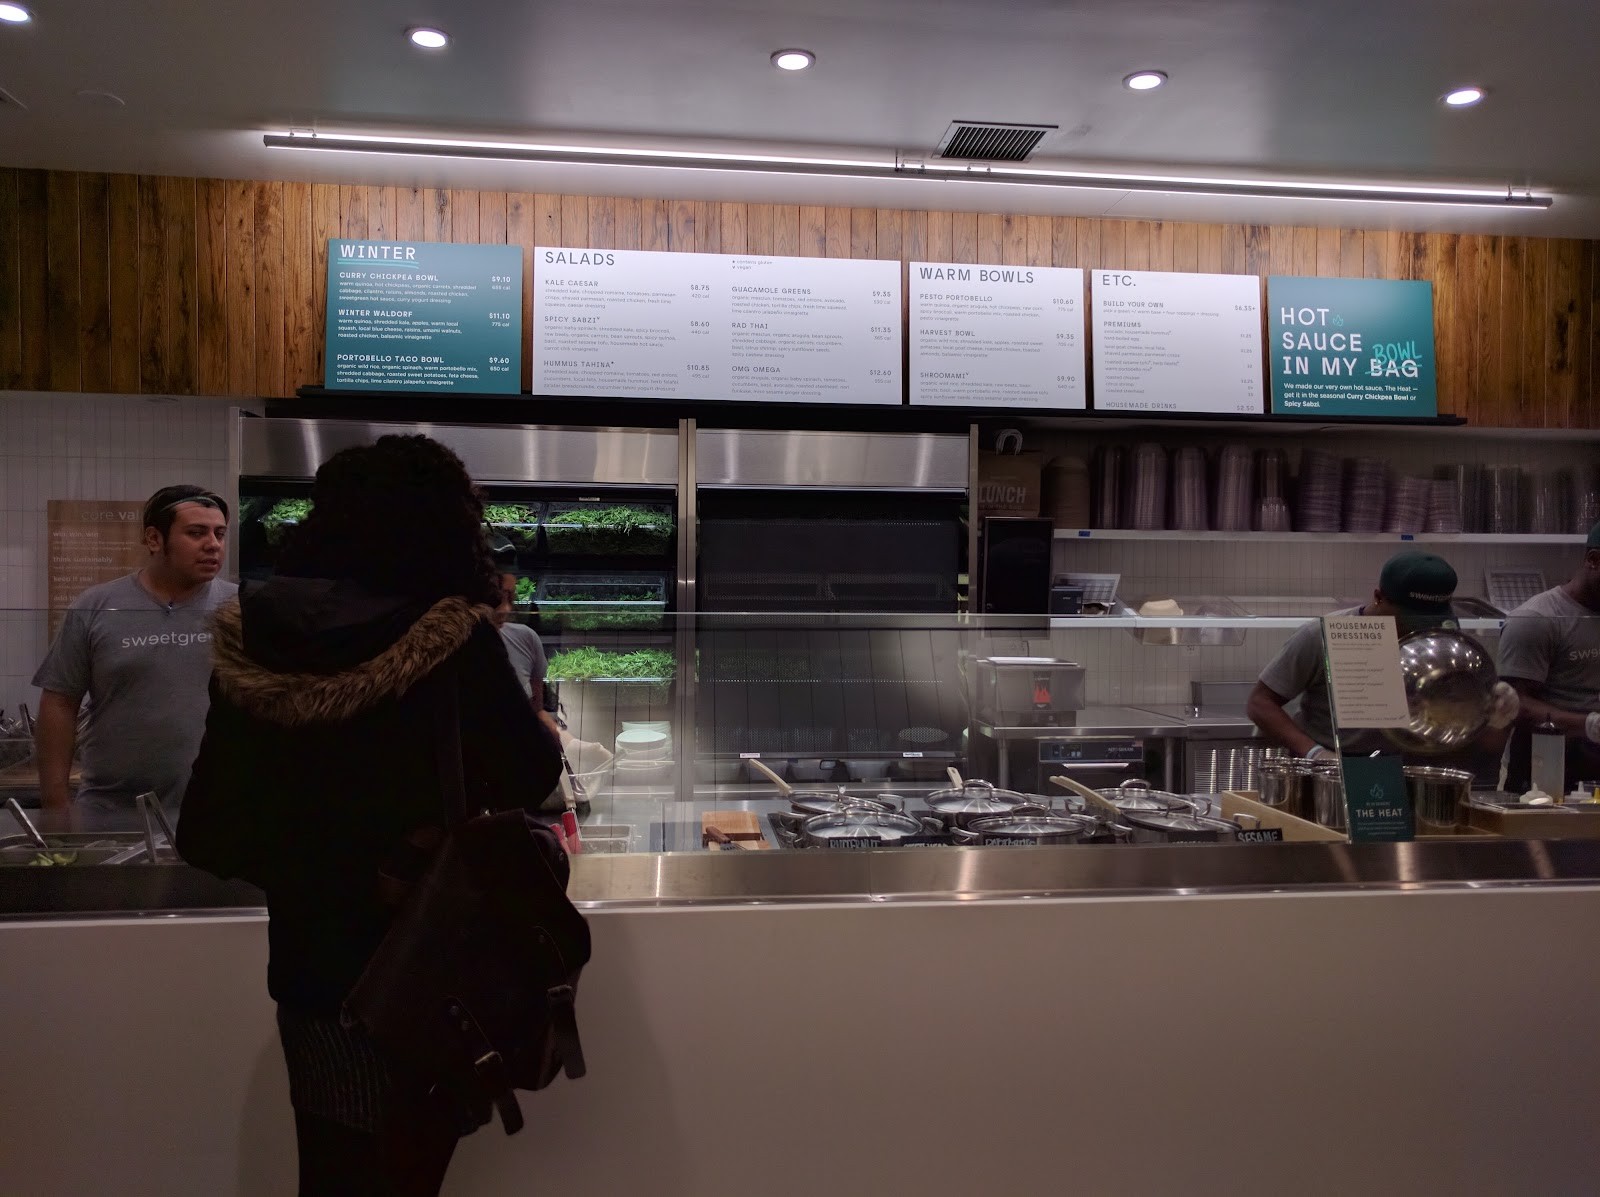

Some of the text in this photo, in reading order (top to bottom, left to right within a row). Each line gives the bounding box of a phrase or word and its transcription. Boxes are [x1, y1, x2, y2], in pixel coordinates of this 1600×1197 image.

[341, 245, 415, 260] WINTER
[546, 252, 614, 265] SALADS
[920, 268, 1033, 283] WARM BOWLS
[1103, 275, 1136, 286] ETC.
[1281, 307, 1329, 326] HOT
[1283, 332, 1362, 352] SAUCE
[1372, 341, 1422, 365] BOWL
[1283, 356, 1418, 377] IN MY BAG
[979, 486, 1025, 503] LUNCH
[82, 511, 113, 520] core
[1356, 808, 1402, 817] THE HEAT
[1238, 831, 1278, 842] SESAME
